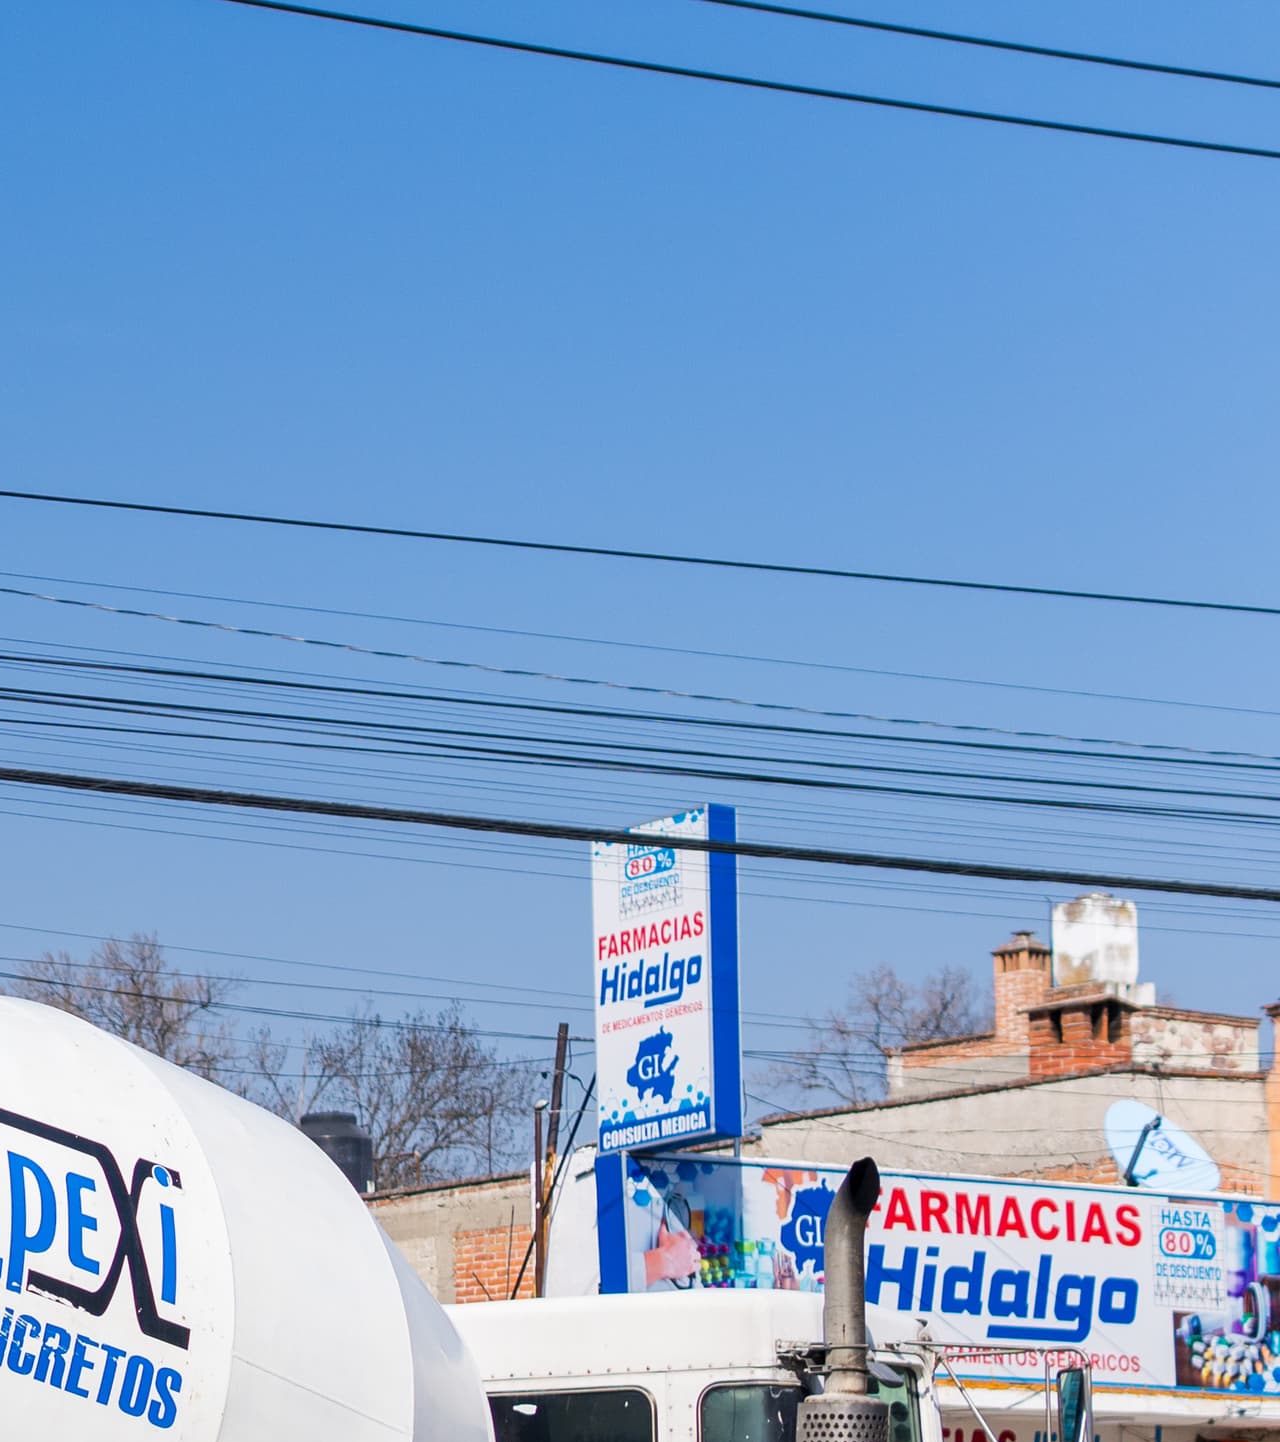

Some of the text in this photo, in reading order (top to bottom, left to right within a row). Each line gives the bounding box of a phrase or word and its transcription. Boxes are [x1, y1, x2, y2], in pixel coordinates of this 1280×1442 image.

[598, 910, 704, 960] FARMACIAS
[600, 952, 702, 1008] Hidalgo
[613, 1009, 663, 1031] MEDICAMENTOS
[603, 1110, 707, 1149] CONSULTA MEDICA
[1161, 1208, 1211, 1227] HASTA
[1156, 1263, 1221, 1281] DE DESCUENTO
[864, 1243, 1139, 1343] Hidalgo
